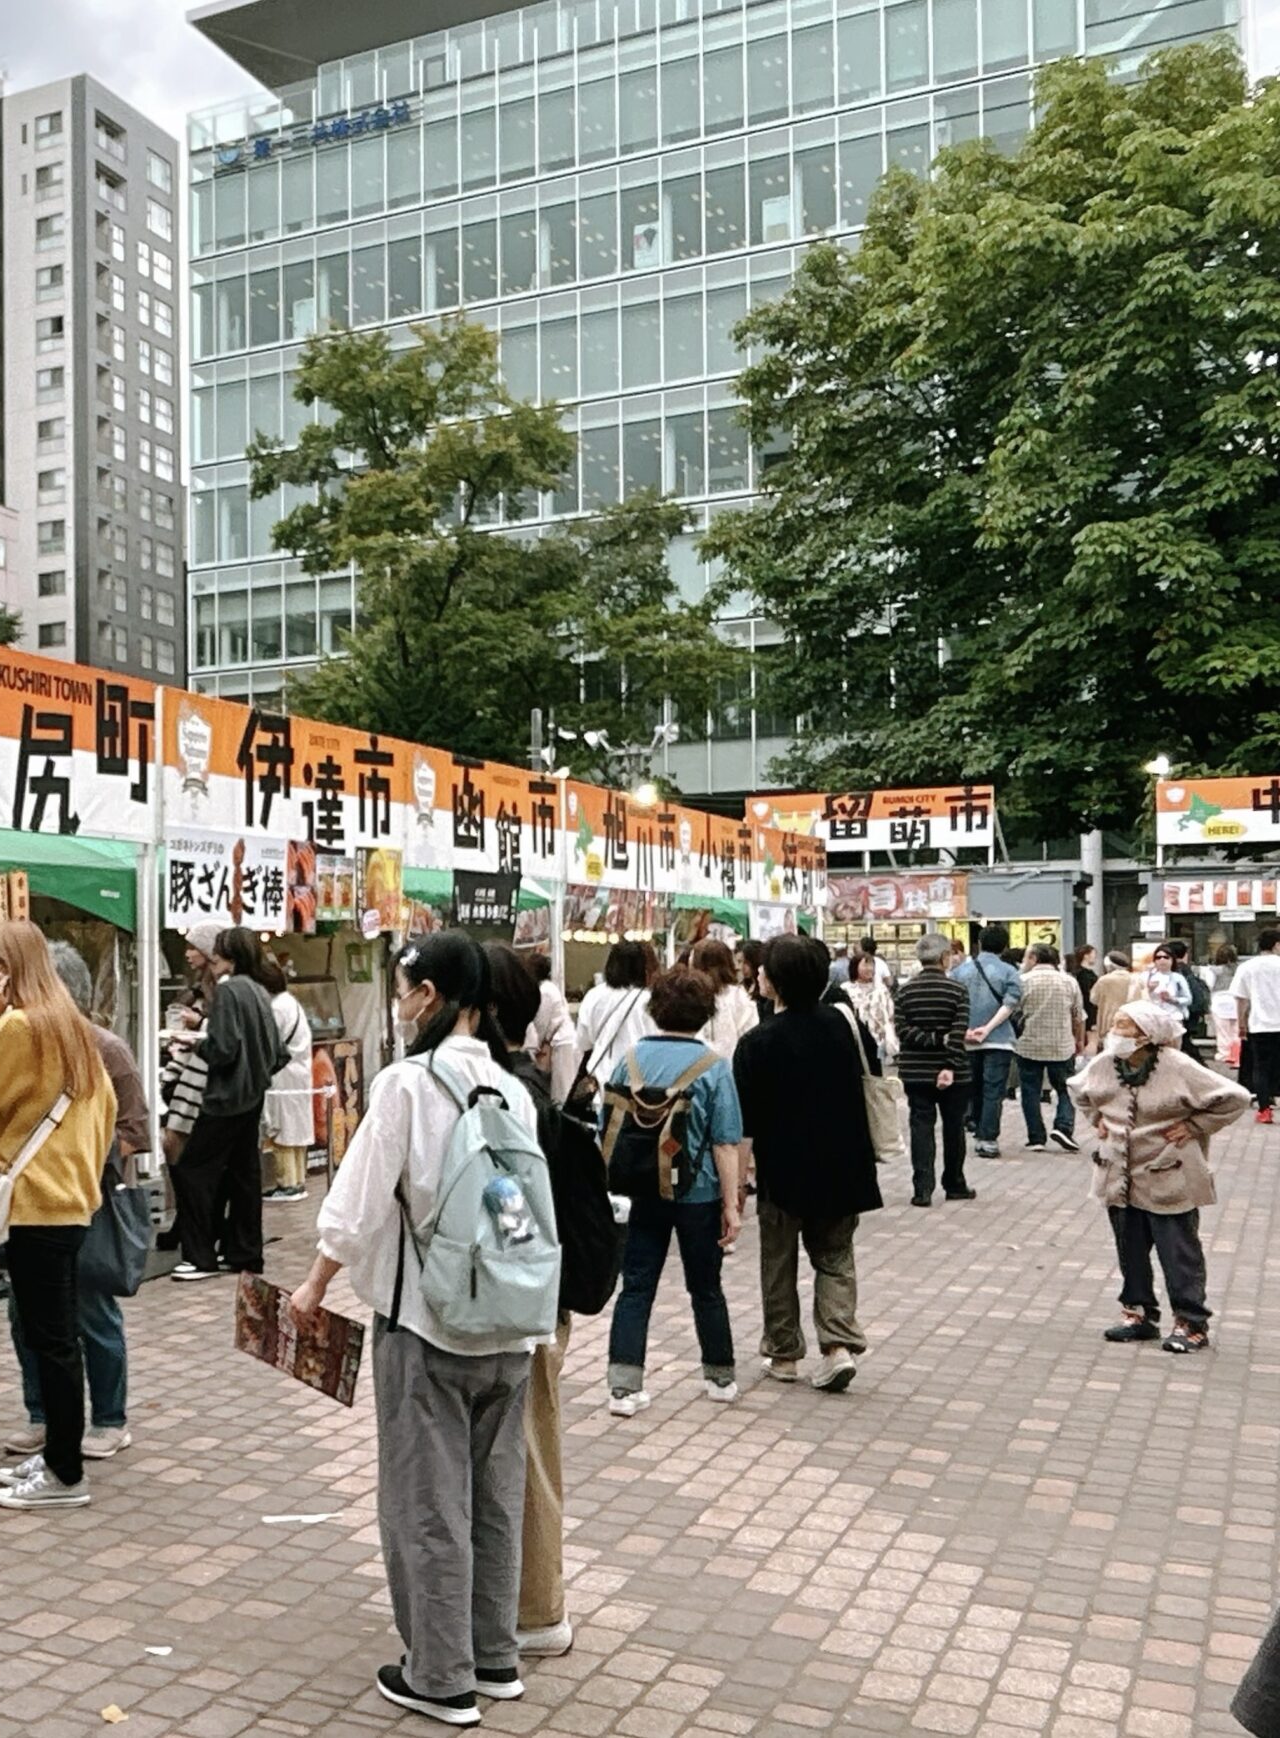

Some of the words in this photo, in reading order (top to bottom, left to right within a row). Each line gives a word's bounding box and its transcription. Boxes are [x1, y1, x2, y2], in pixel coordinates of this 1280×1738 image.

[53, 676, 93, 706] TOWN
[236, 708, 394, 856] 伊達市
[916, 794, 936, 803] CITY
[821, 786, 991, 849] 留萌市
[169, 859, 283, 917] 豚ざんぎ棒
